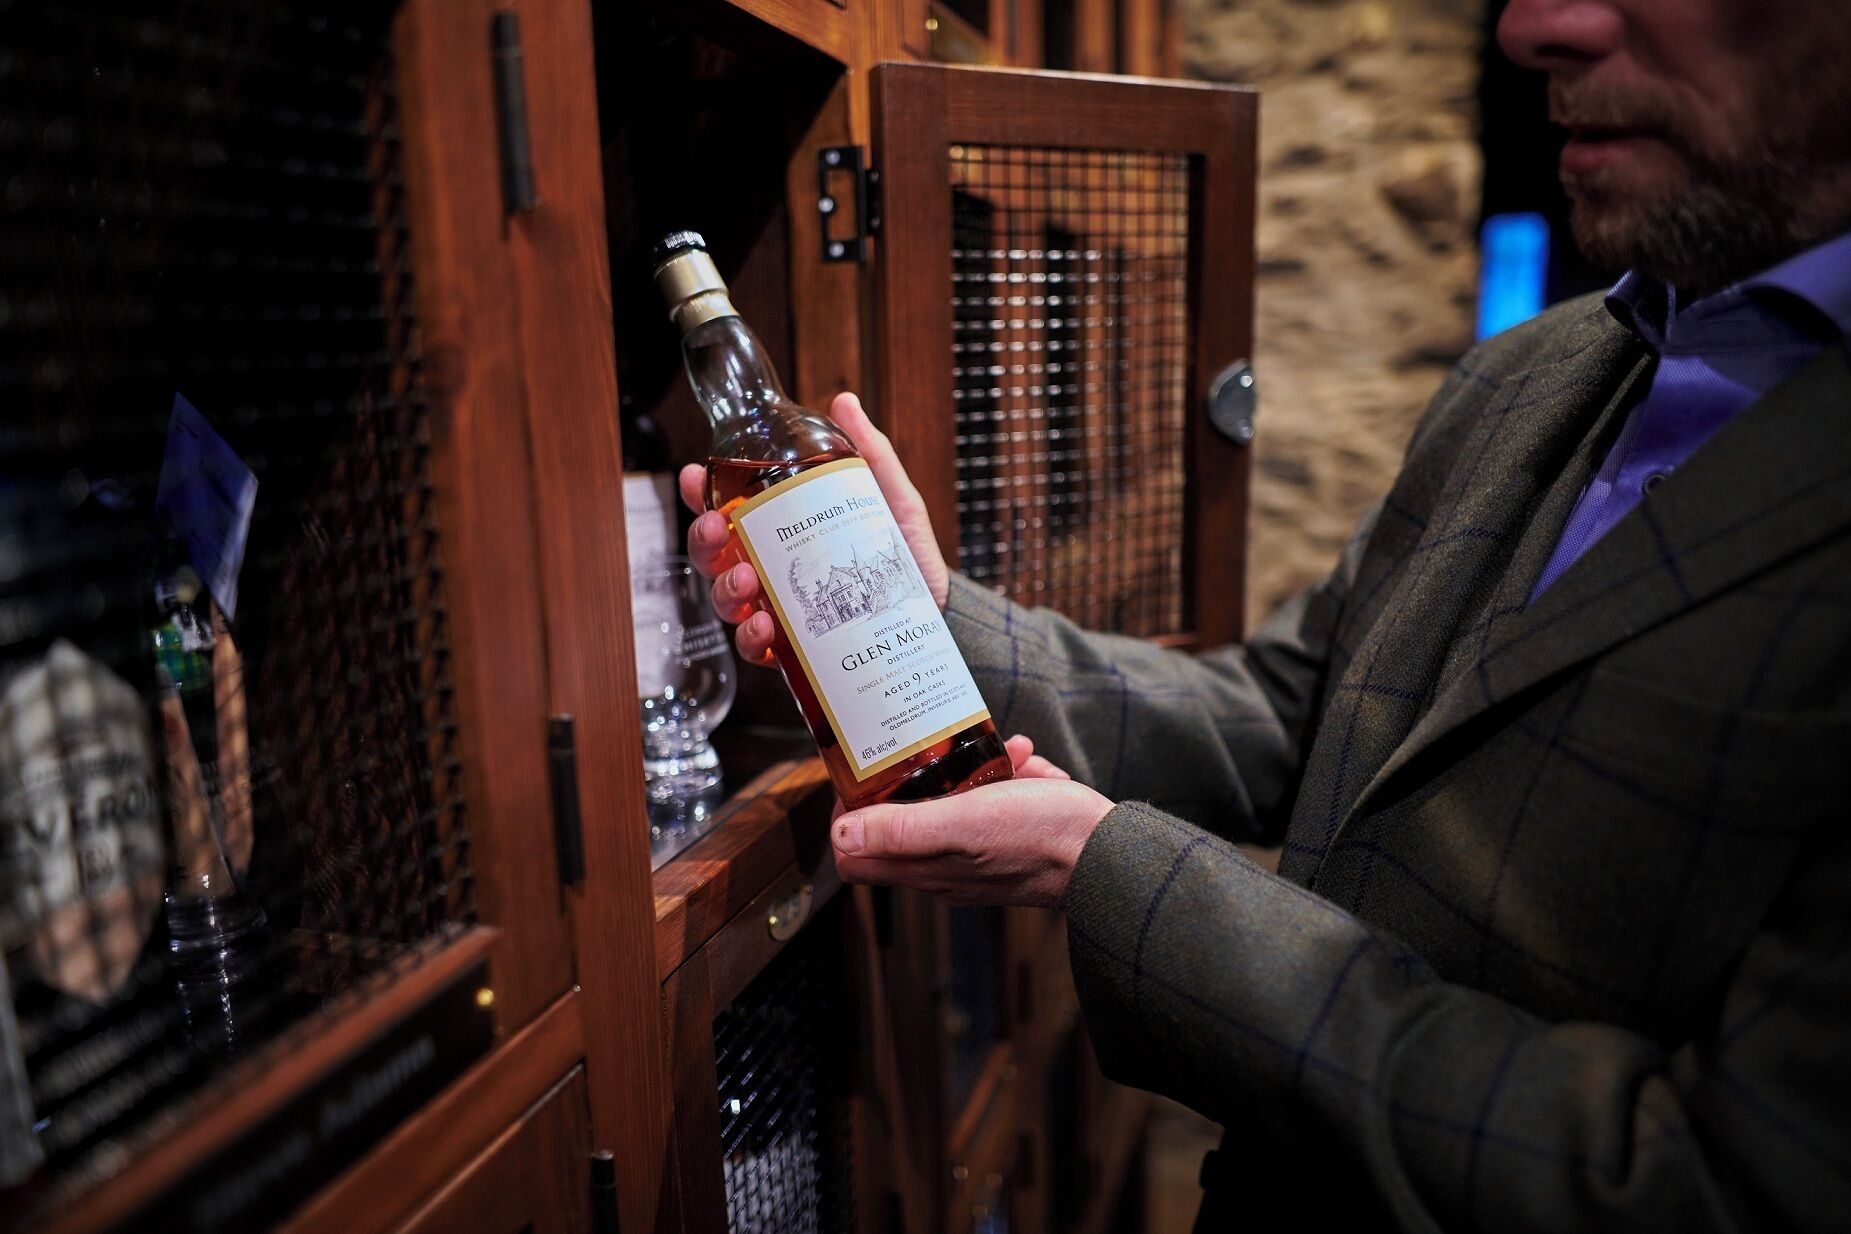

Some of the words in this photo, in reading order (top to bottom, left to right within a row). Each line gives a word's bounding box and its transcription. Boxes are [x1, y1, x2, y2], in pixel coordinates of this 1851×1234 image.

[785, 534, 816, 552] WHISKY
[819, 525, 840, 536] CLUB
[860, 510, 884, 521] BOTT
[874, 620, 905, 638] DISTILLED
[904, 617, 912, 625] AT
[841, 640, 892, 671] GLEN
[887, 643, 927, 665] DISTILLERY
[857, 677, 885, 694] SINGLE
[885, 666, 907, 681] MALT
[884, 680, 911, 698] AGED
[912, 672, 921, 686] 9
[924, 663, 949, 678] YEARS
[903, 695, 912, 703] IN
[912, 689, 928, 699] OAK
[928, 680, 946, 692] CASKS
[881, 710, 908, 727] DISTILLED
[908, 704, 921, 714] AND
[921, 694, 943, 707] BOTTLED
[948, 683, 967, 694] SCOT
[861, 747, 877, 760] 46%
[877, 737, 898, 753] alc/vol
